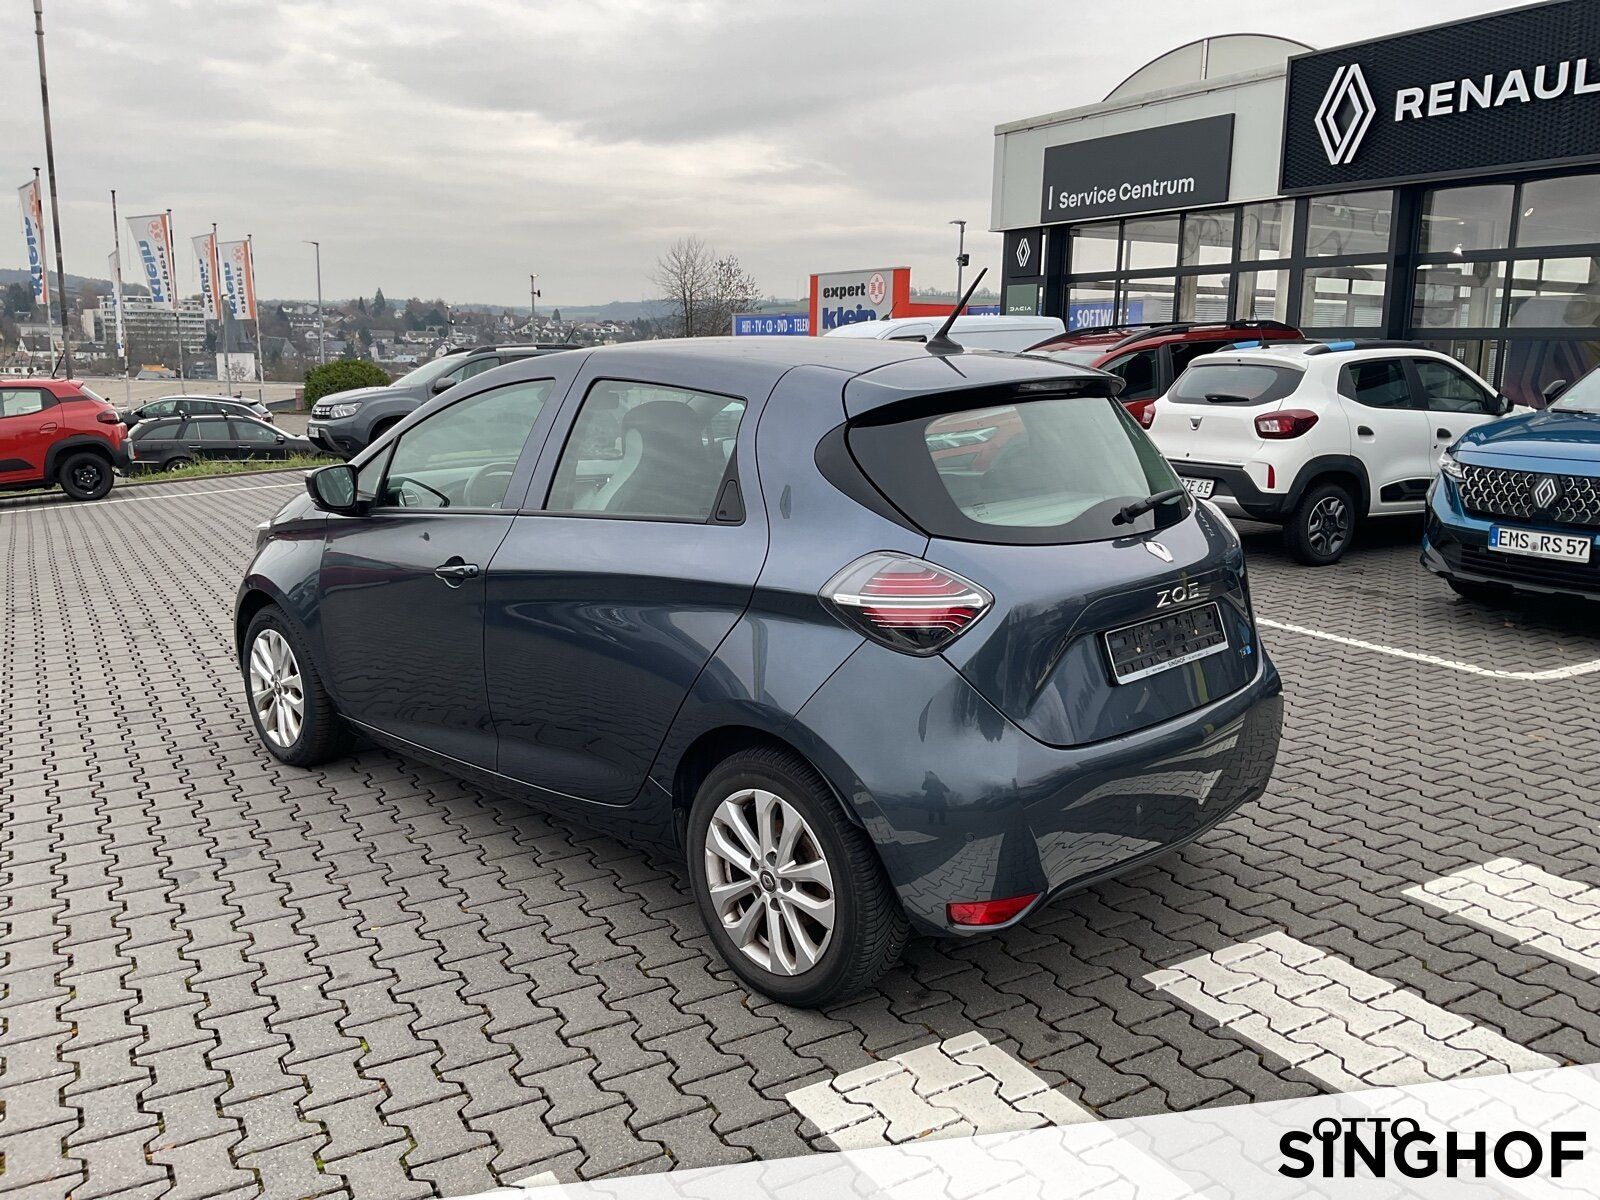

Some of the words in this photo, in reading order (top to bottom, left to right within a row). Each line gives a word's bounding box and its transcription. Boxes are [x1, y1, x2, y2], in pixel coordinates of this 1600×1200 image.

[1395, 58, 1600, 122] RENAUL
[1059, 186, 1117, 209] Service
[1119, 177, 1195, 201] Centrum
[823, 283, 866, 300] expert
[755, 320, 762, 333] TV
[777, 320, 788, 333] DVD
[822, 304, 877, 330] klein
[1499, 530, 1529, 549] EMS
[1540, 536, 1562, 553] RS
[1566, 538, 1588, 556] 57
[1156, 582, 1199, 608] ZOE
